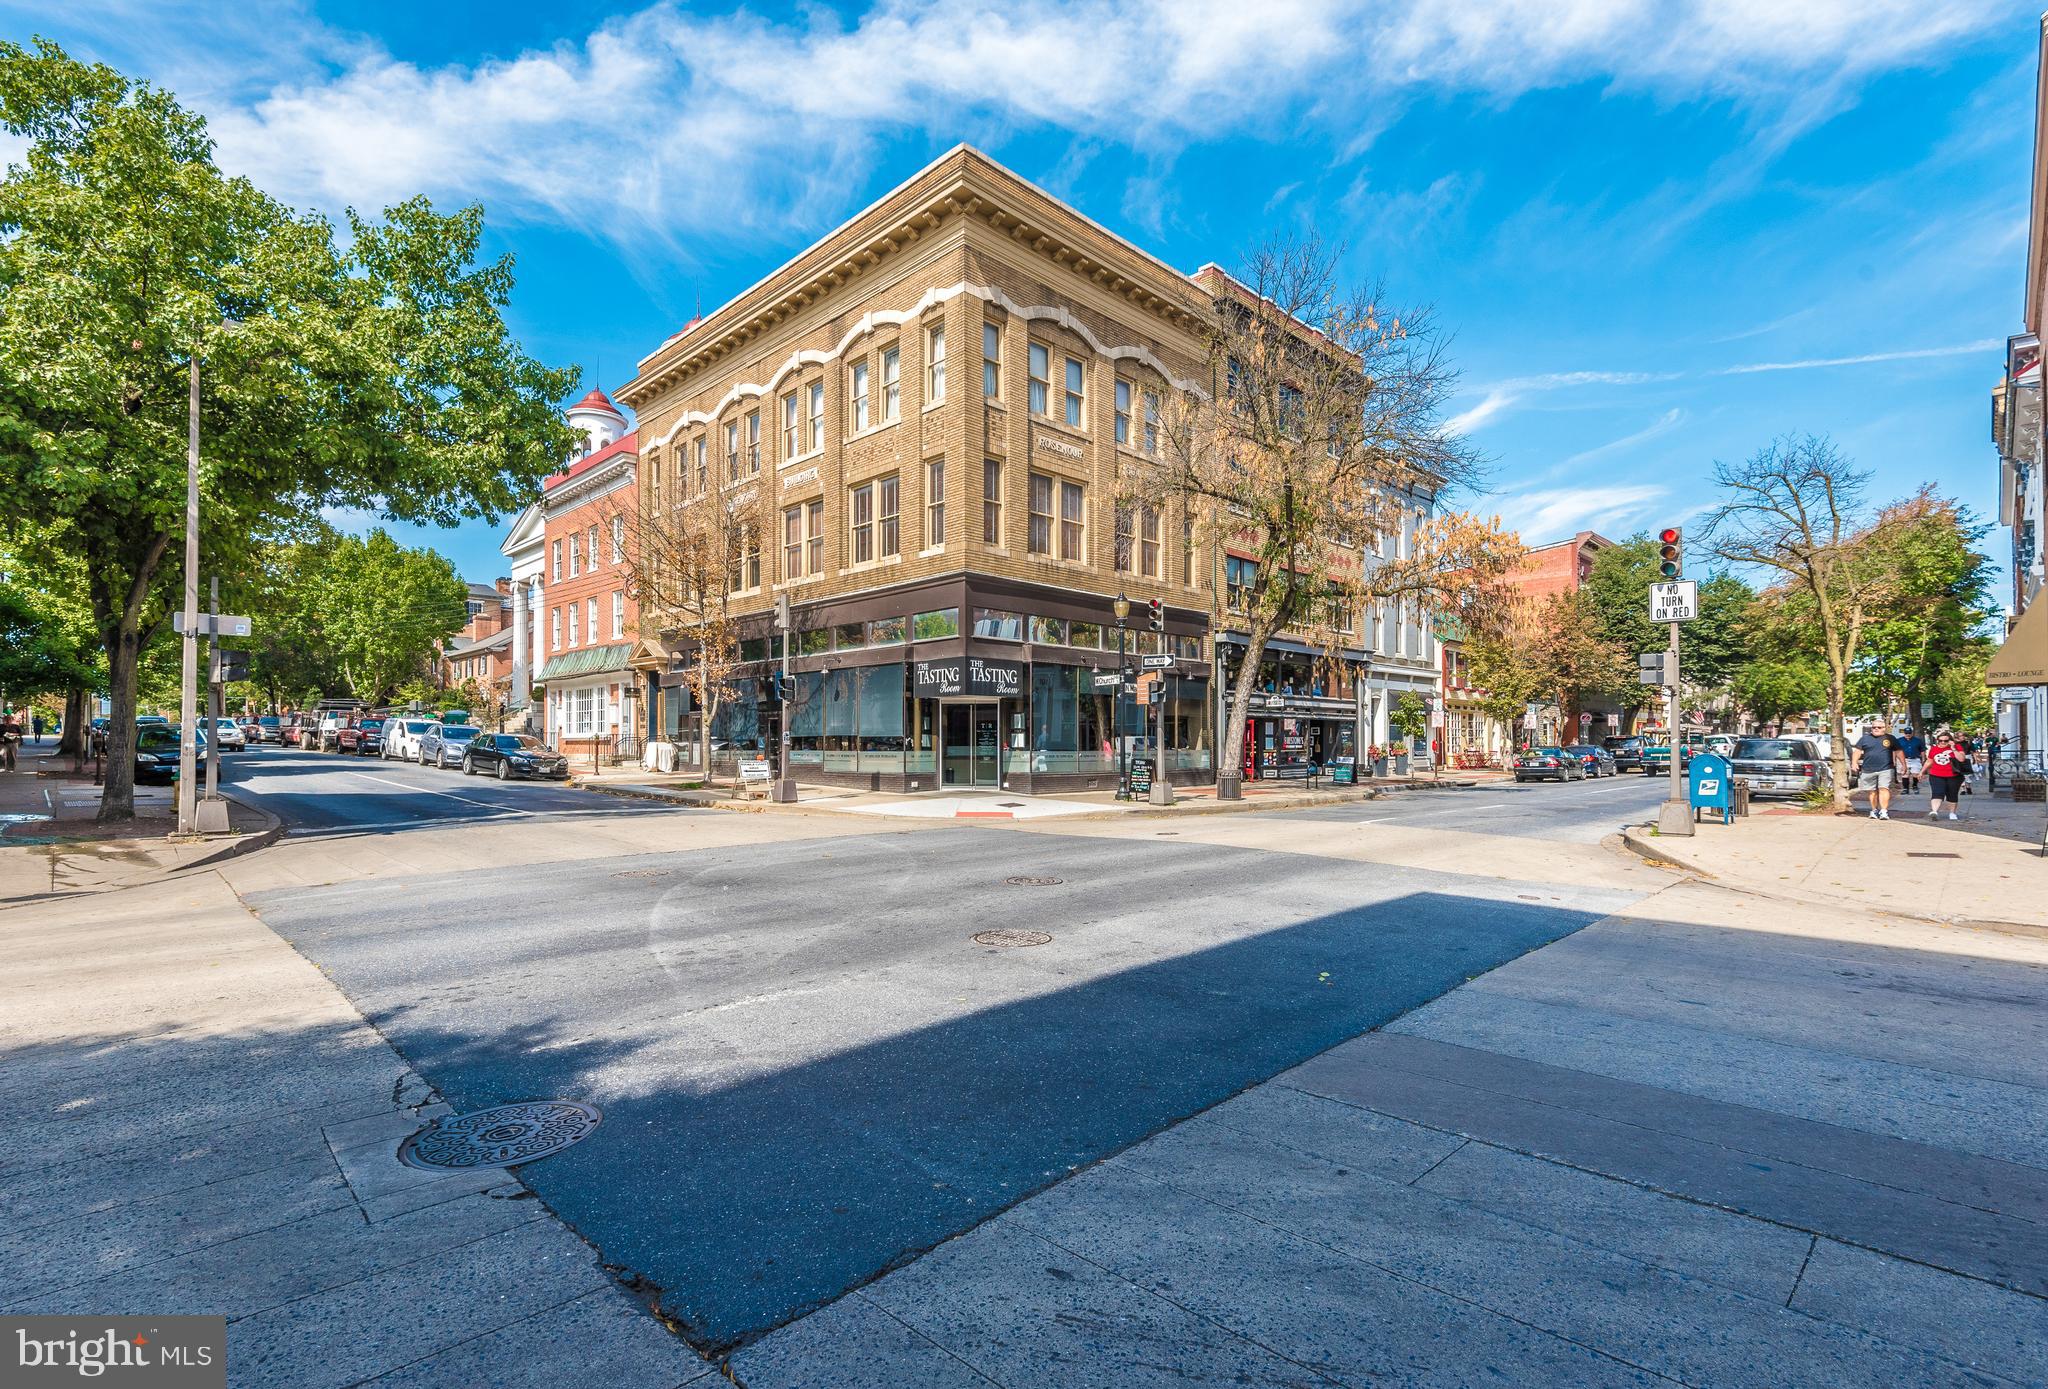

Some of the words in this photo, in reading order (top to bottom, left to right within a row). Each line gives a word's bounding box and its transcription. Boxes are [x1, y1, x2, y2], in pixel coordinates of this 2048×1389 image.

[1667, 584, 1678, 595] NO
[1661, 595, 1683, 607] TURN
[1656, 608, 1668, 619] ON
[1672, 606, 1689, 618] RED
[918, 663, 929, 671] THE
[970, 659, 984, 668] THE
[918, 667, 960, 684] TASTING
[970, 666, 1018, 684] TASTING
[940, 681, 961, 693] Room
[997, 681, 1020, 694] Room
